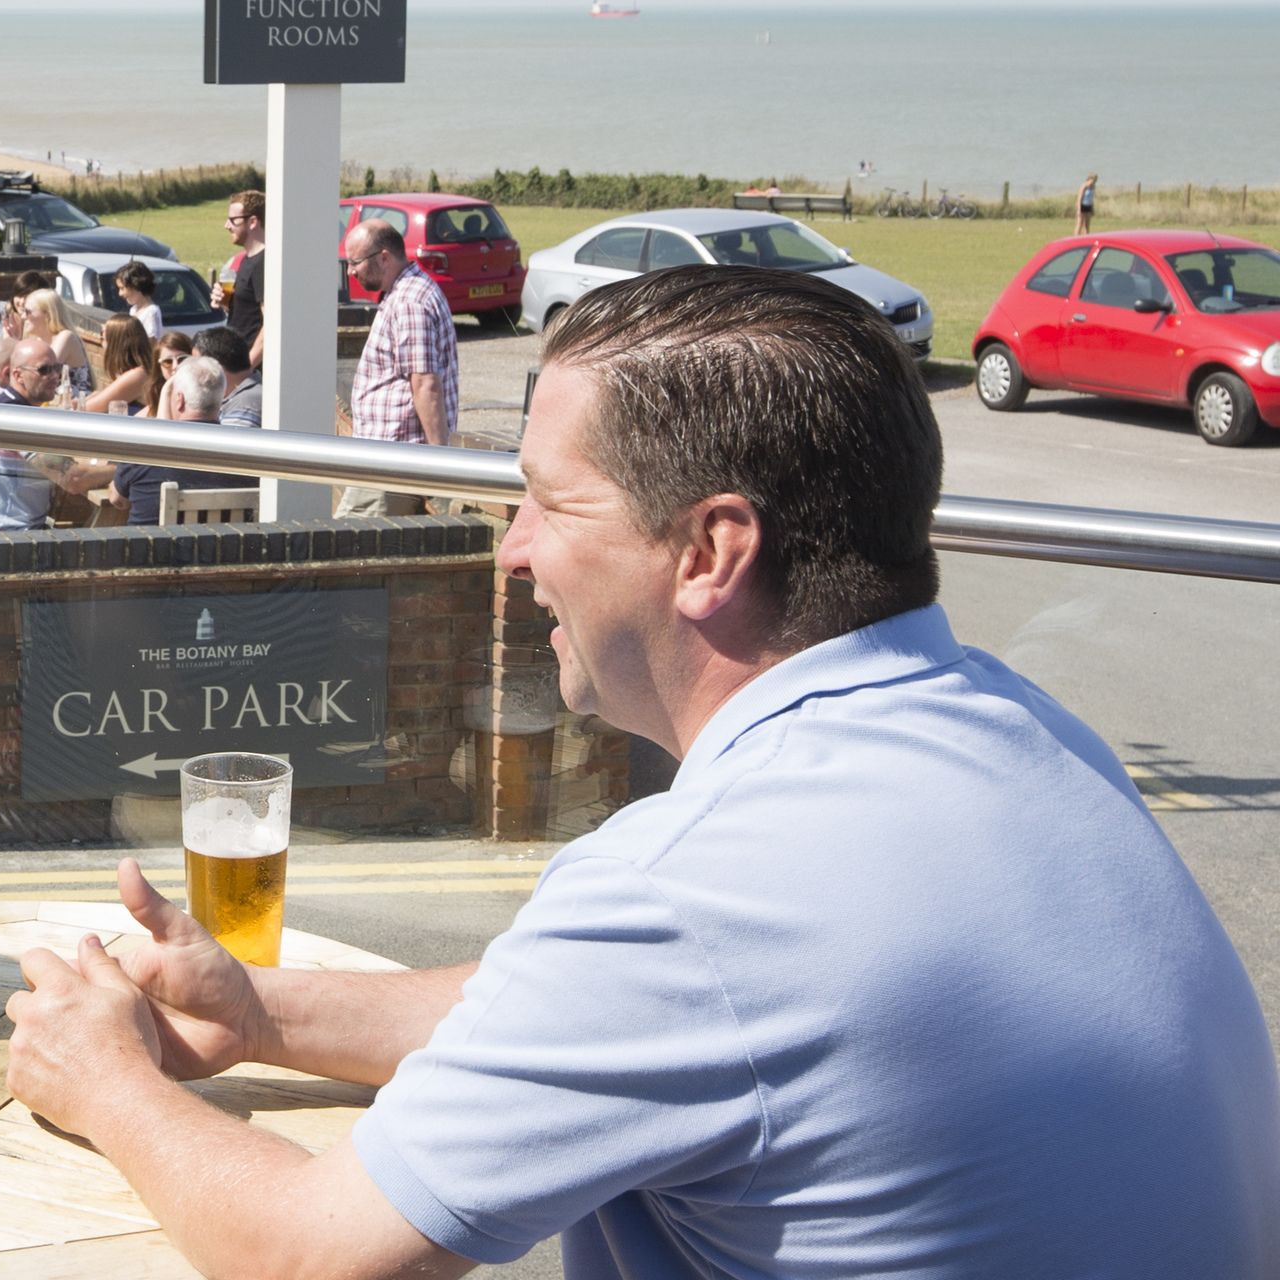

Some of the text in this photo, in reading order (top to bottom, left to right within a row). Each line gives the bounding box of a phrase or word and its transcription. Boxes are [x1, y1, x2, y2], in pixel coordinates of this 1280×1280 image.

[268, 25, 360, 47] ROOMS
[138, 643, 271, 661] THE BOTANY BAY
[52, 679, 357, 737] CAR PARK
